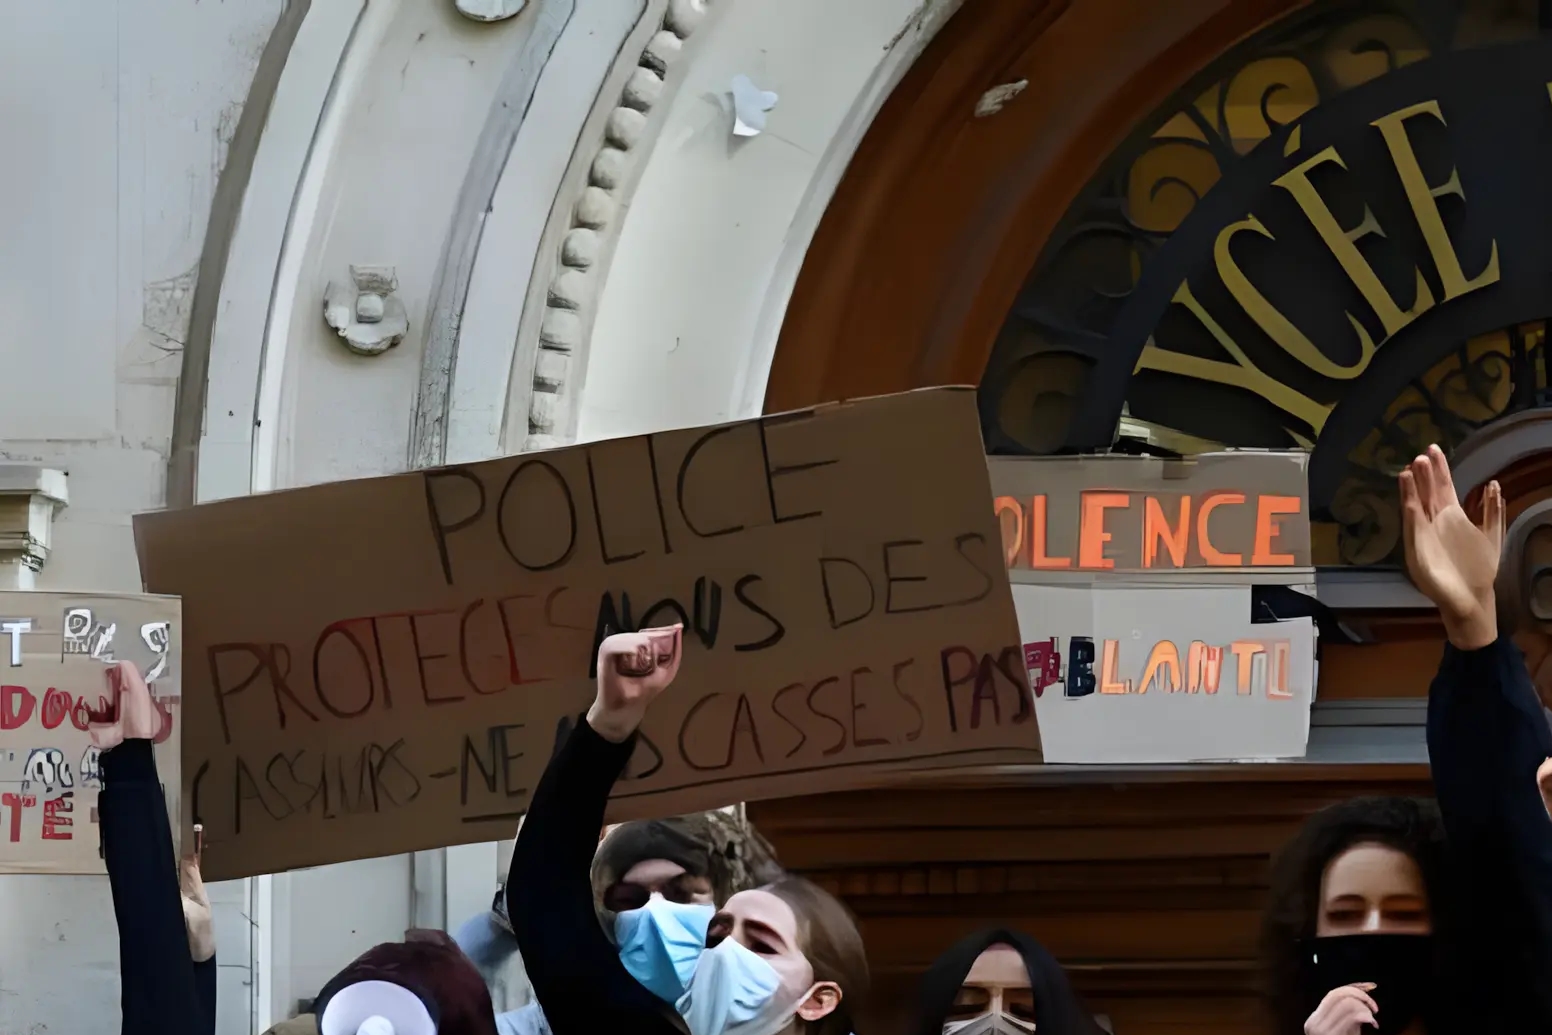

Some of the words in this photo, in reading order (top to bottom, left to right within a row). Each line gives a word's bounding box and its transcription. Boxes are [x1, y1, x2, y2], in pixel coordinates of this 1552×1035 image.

[422, 411, 838, 584] POLICE
[994, 490, 1300, 568] OLENCE
[819, 531, 992, 629] DES
[941, 645, 1035, 733] PAS
